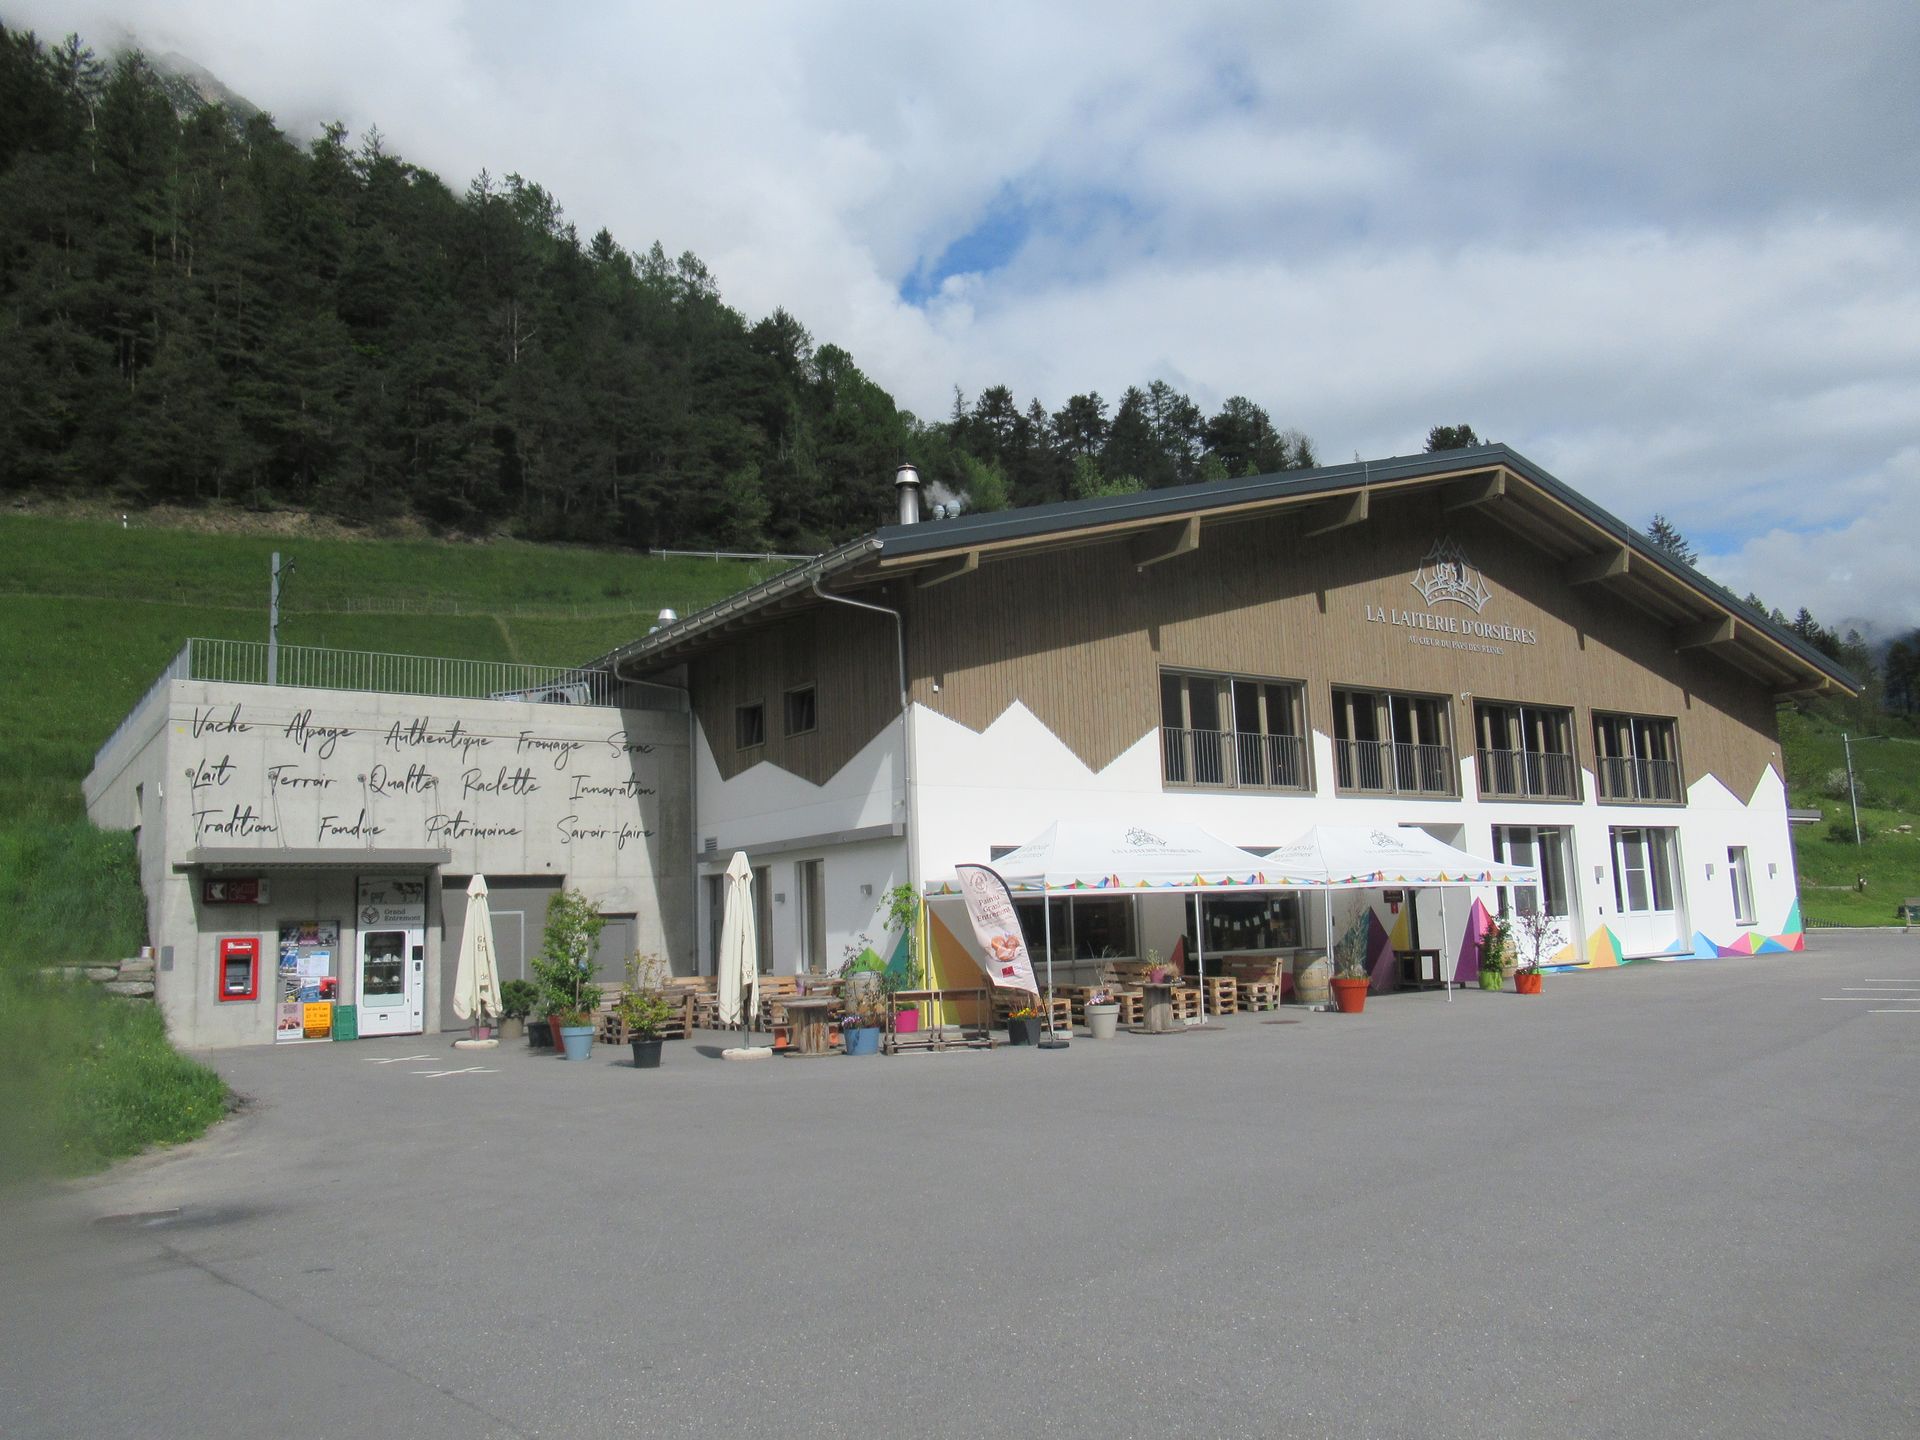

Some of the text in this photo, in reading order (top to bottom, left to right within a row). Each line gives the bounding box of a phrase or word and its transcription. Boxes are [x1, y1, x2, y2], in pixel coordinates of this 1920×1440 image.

[1365, 605, 1537, 645] LA LAITERIE D'ORSIÈRES
[1408, 635, 1418, 645] AU
[192, 703, 254, 739] Vache
[284, 708, 356, 760] Alpage
[384, 716, 494, 765] Authentique
[517, 730, 585, 771] Fromage
[193, 755, 656, 801] Lait Terroir Qualité Raclette Innovation
[192, 804, 656, 850] Tradition Fondue Patrimoine Savoir-faire
